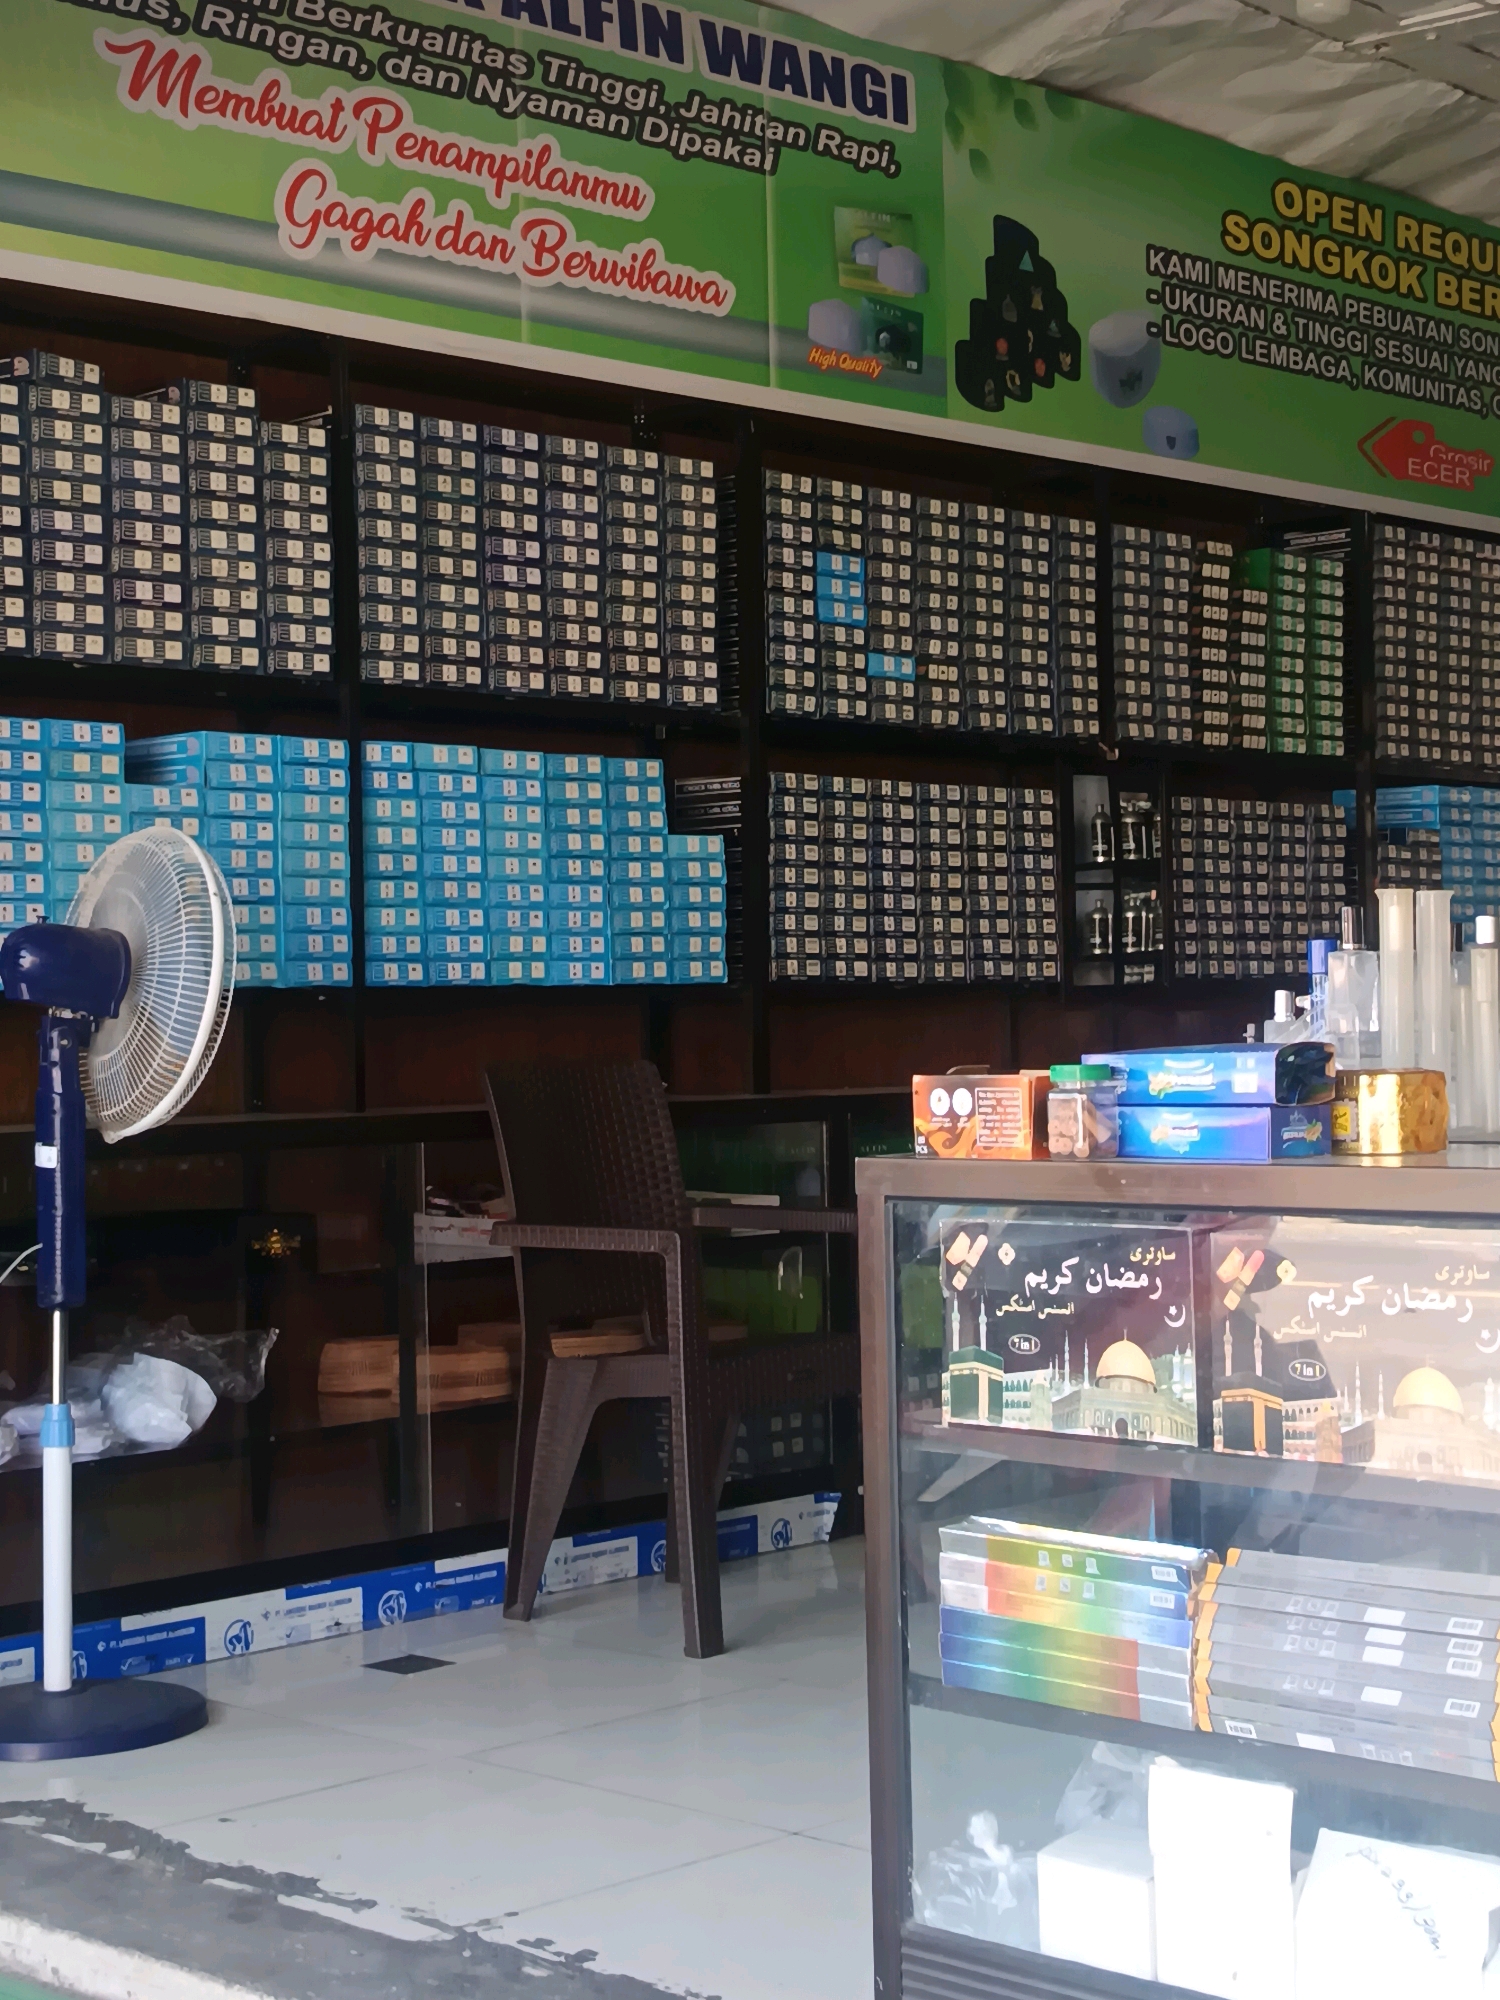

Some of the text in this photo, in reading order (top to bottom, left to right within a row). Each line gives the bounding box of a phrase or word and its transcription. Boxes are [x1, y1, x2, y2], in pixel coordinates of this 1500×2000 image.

[200, 3, 369, 75] Ringan,
[385, 54, 460, 94] dan
[474, 77, 630, 135] Nyaman
[642, 116, 775, 171] Dipakai
[294, 0, 897, 174] Berkualitas Tinggi, Jahitan Rapi,
[699, 19, 909, 126] WANGI
[104, 38, 647, 213] Membuat Penampilanmu
[284, 168, 729, 308] Gagah dan Berwibawa
[1273, 181, 1384, 242] OPEN
[1149, 249, 1499, 356] KAMI MENERIMA PEBUATAN SON
[1223, 214, 1500, 319] SONGKOK BER
[809, 348, 883, 379] High Quality
[1165, 286, 1266, 330] UKURAN
[1272, 313, 1288, 336] &
[1294, 316, 1368, 354] TINGGI
[1374, 338, 1448, 373] SESUAI
[1165, 320, 1234, 354] LOGO
[1241, 337, 1358, 387] LEMBAGA,
[1364, 366, 1487, 415] KOMUNITAS,
[1408, 458, 1471, 486] ECER
[1430, 445, 1491, 472] Grosir
[1024, 1256, 1163, 1300] رمضان كريم
[1307, 1275, 1474, 1323] رمضان كريم
